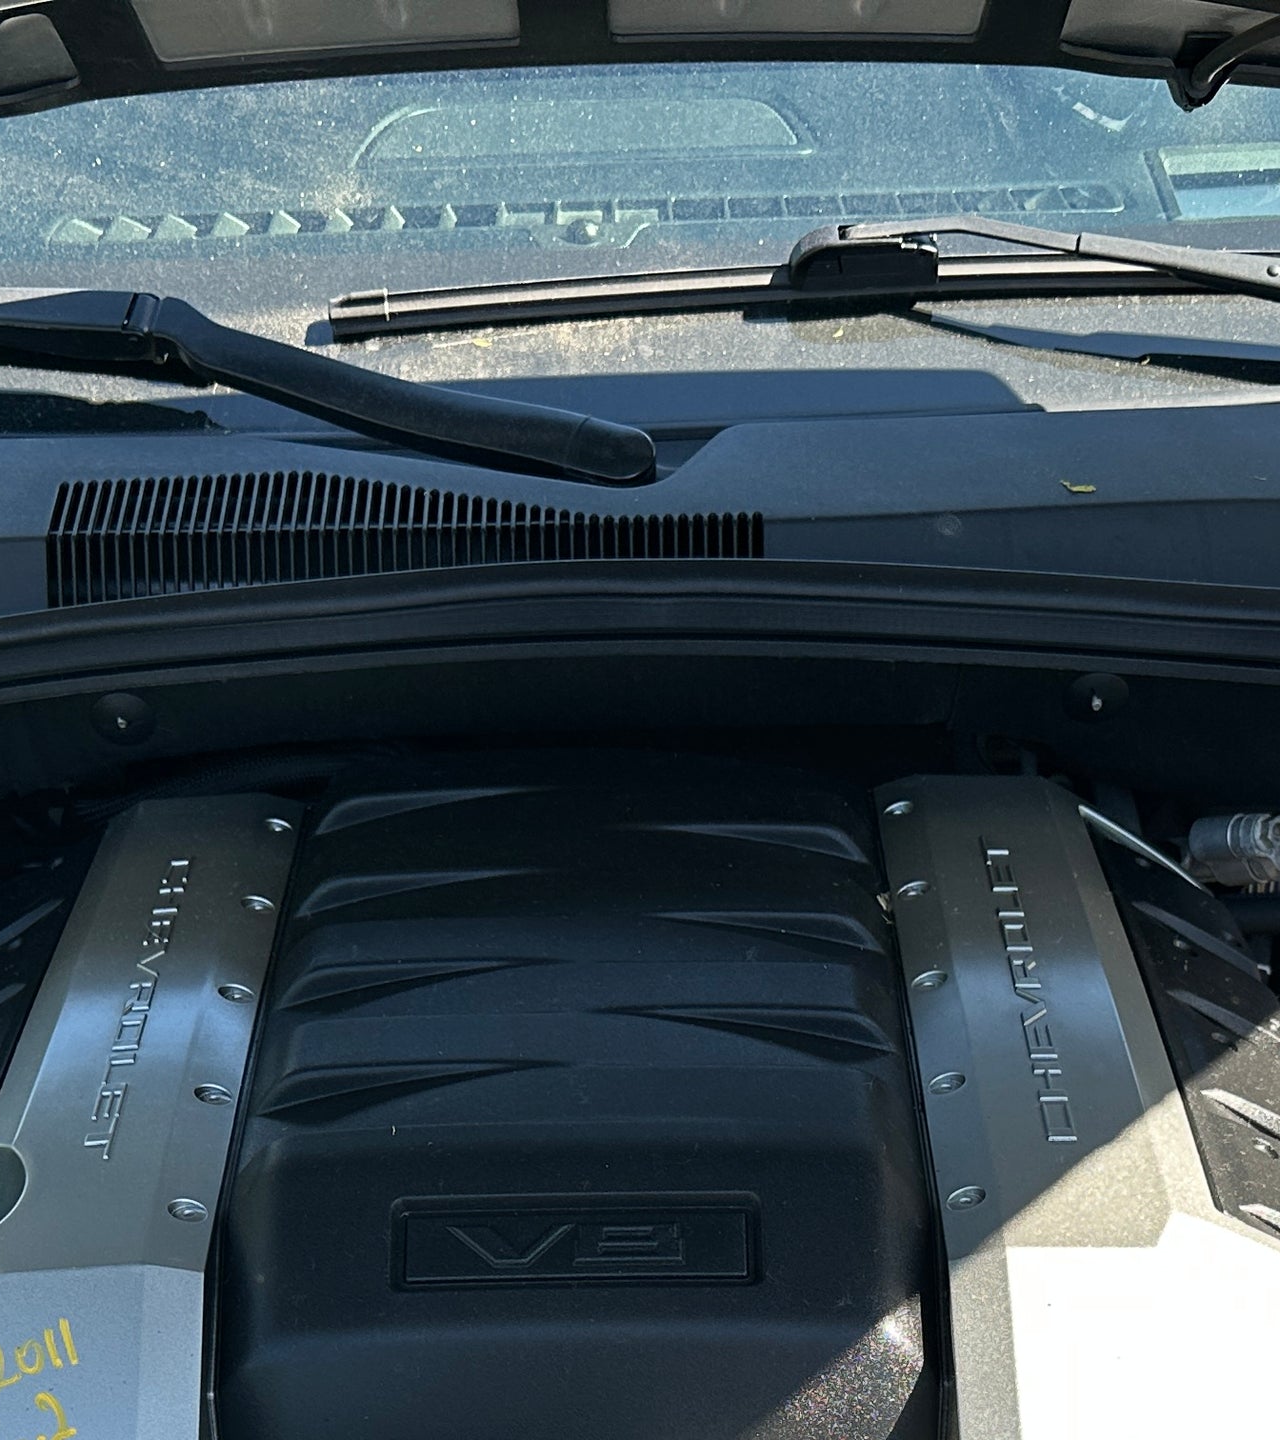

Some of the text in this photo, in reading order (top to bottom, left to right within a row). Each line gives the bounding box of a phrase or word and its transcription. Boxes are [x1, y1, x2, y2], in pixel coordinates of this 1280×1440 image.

[84, 858, 191, 1161] CHEVROLET
[979, 834, 1078, 1141] CHEVROLET
[445, 1222, 686, 1269] V8
